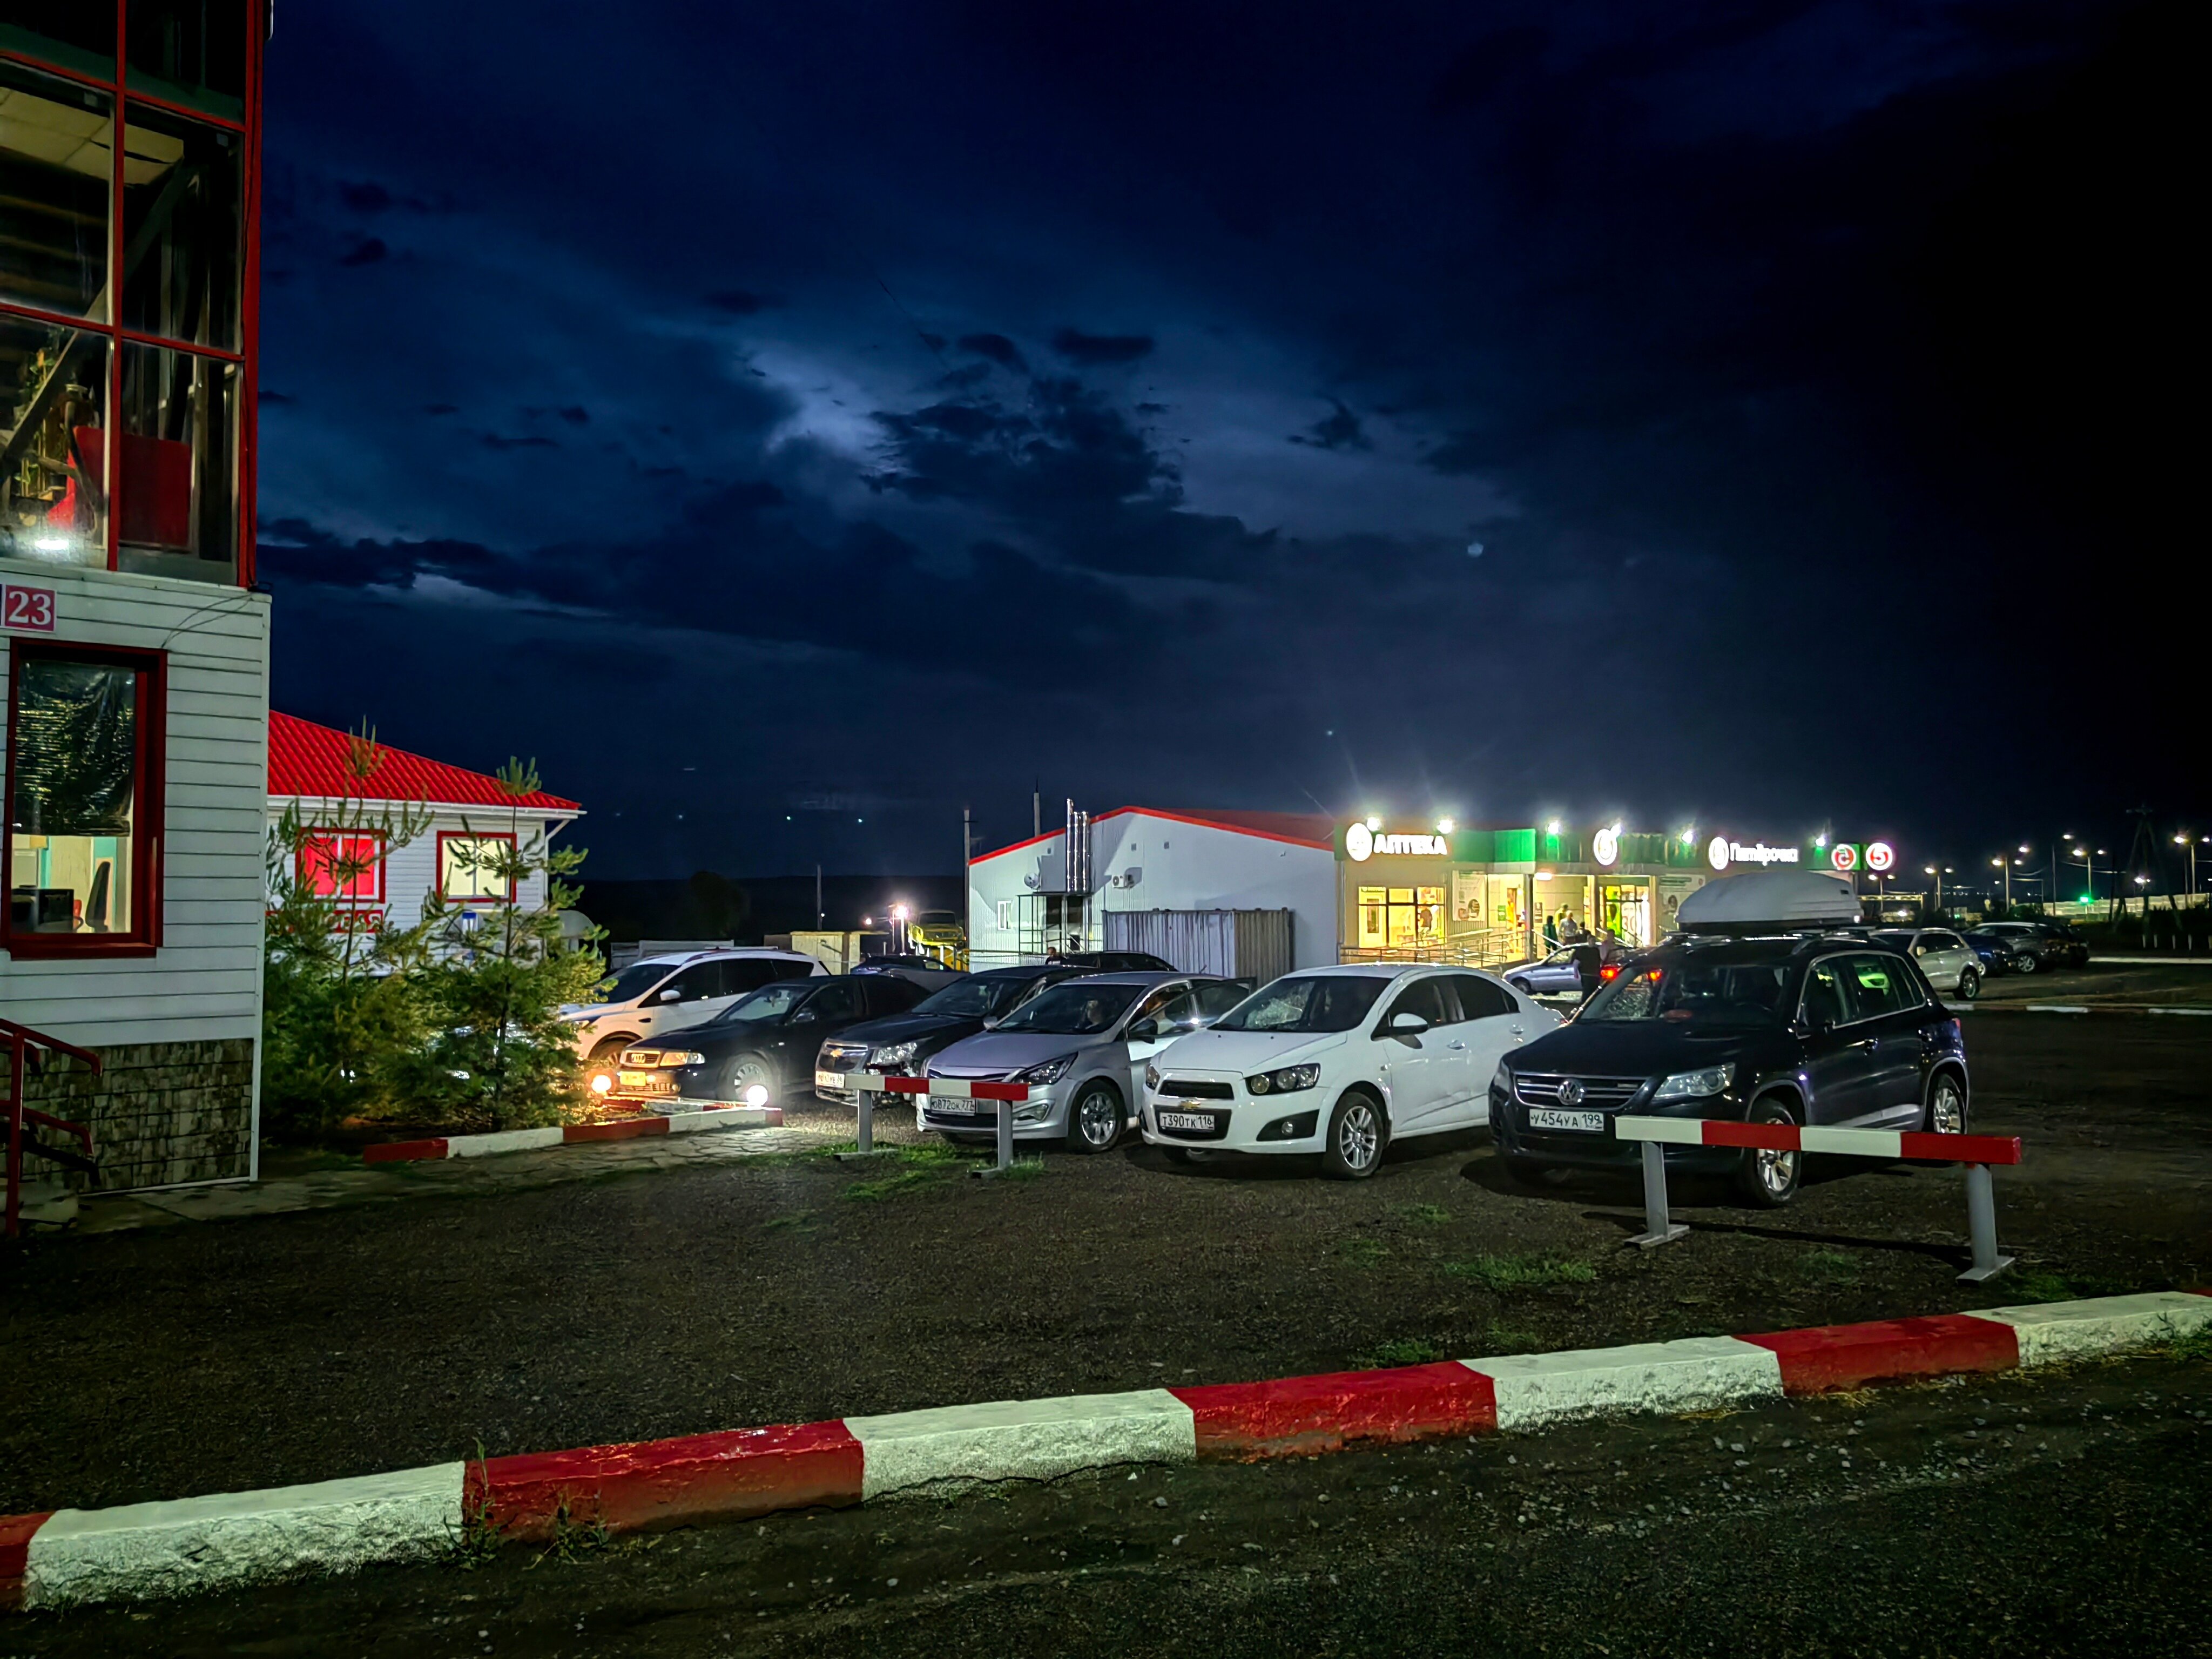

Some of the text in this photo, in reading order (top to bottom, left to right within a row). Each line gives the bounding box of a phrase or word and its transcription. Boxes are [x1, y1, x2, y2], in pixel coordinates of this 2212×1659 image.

[9, 590, 51, 625] 23
[1373, 834, 1447, 855] АПТЕКА
[1163, 1115, 1212, 1128] Т390ТК 116
